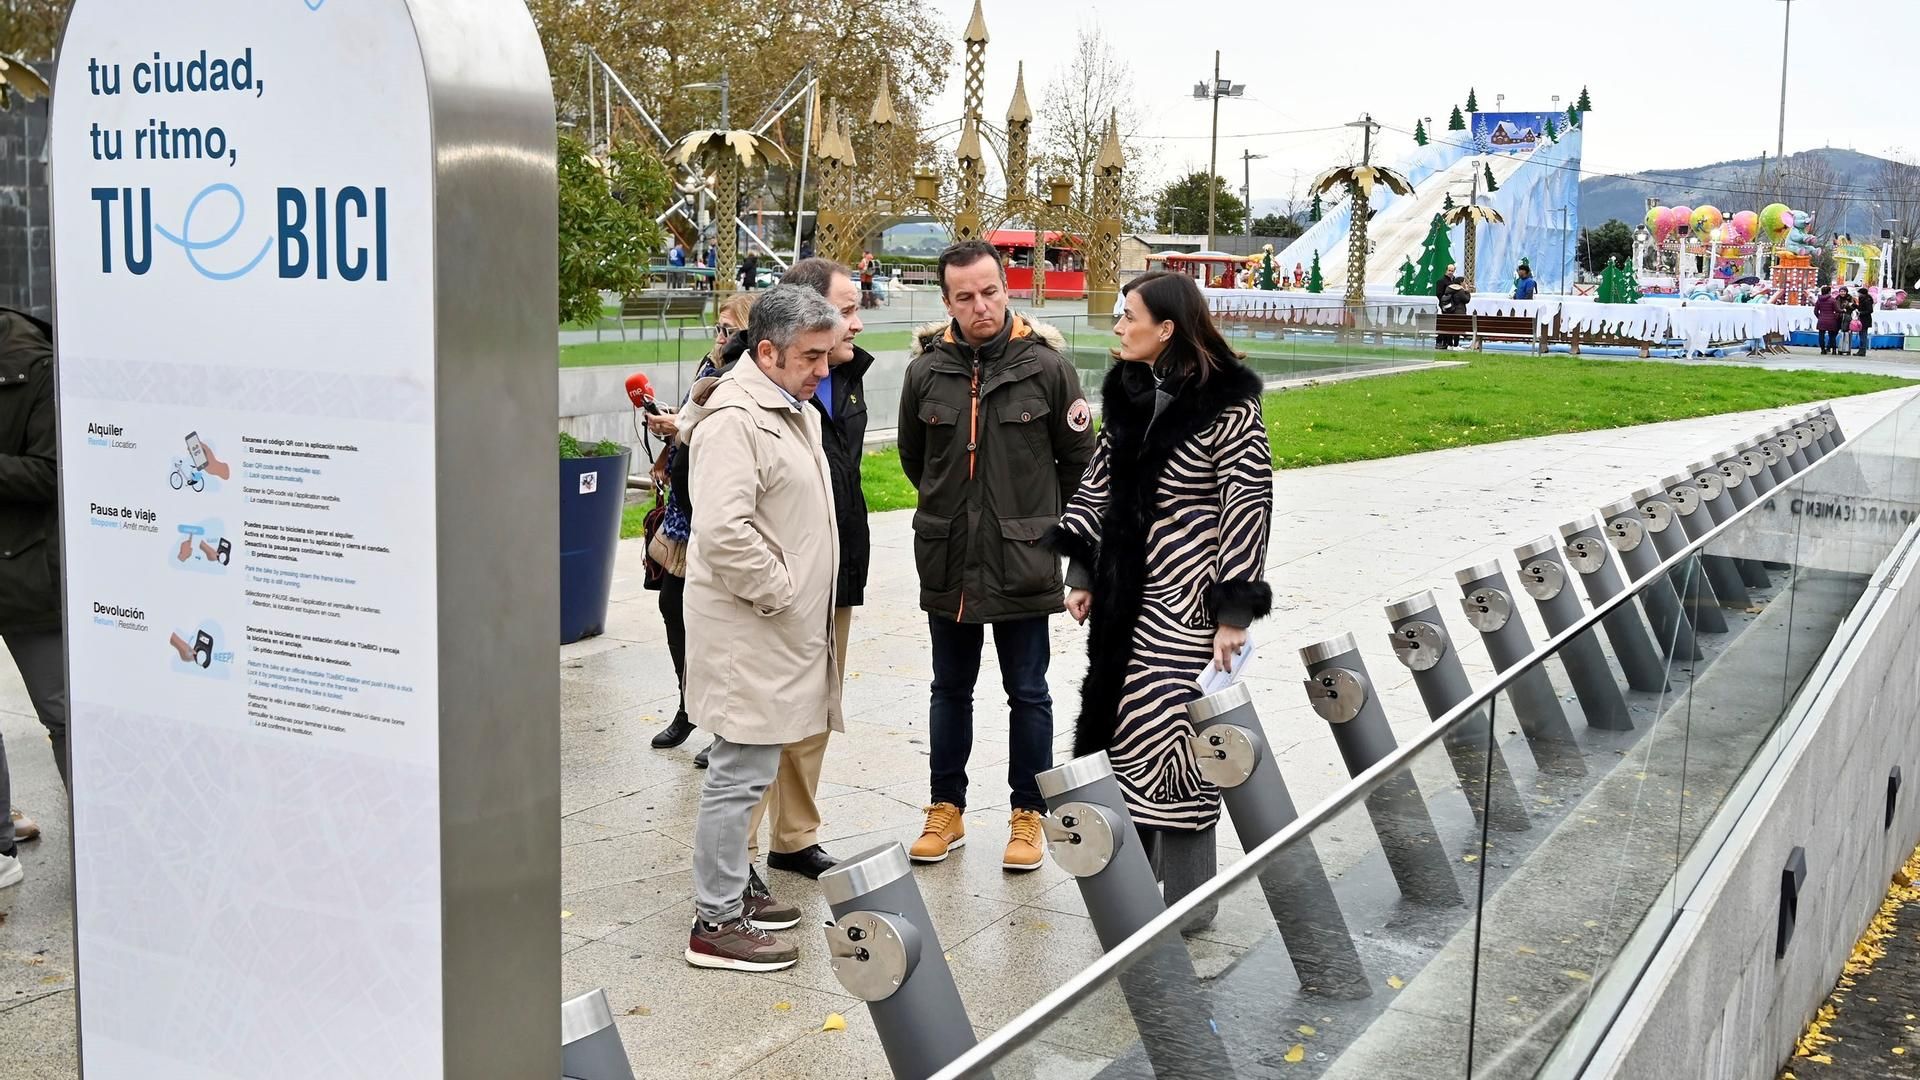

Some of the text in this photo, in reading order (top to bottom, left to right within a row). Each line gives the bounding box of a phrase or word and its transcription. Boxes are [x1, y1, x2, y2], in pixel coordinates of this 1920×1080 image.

[88, 48, 263, 98] tu ciudad,
[90, 119, 236, 167] tu ritmo,
[88, 422, 123, 437] Alquiler
[90, 503, 156, 523] Pausa de viaje
[93, 601, 145, 620] Devolución
